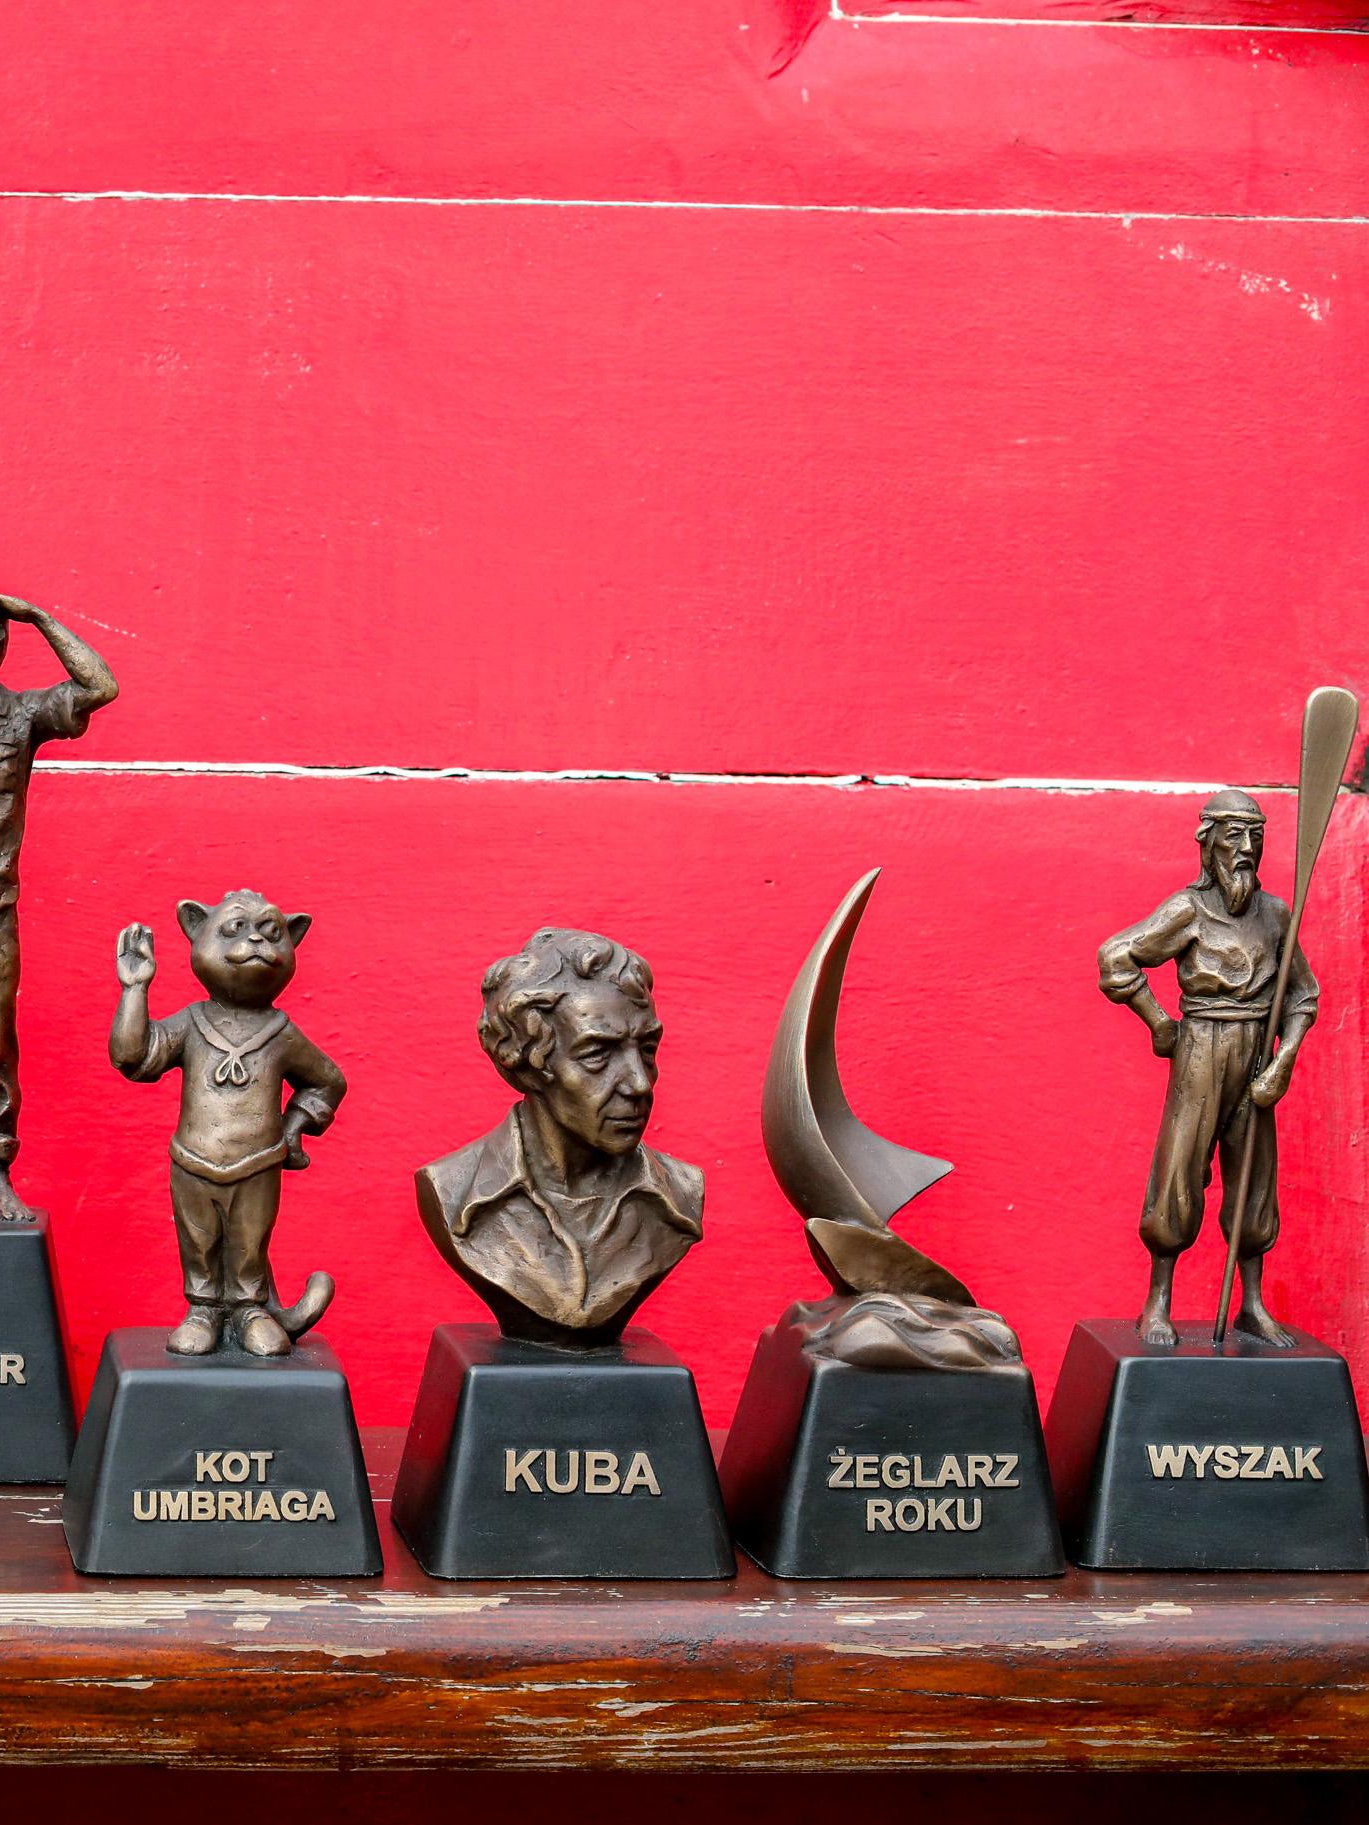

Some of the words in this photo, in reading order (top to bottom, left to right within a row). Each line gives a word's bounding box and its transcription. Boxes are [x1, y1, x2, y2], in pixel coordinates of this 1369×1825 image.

[195, 1450, 274, 1482] KOT
[503, 1447, 661, 1496] KUBA
[826, 1445, 1020, 1489] ŻEGLARZ
[1144, 1443, 1324, 1480] WYSZAK
[133, 1489, 336, 1522] UMBRIAGA
[865, 1496, 983, 1533] ROKU
